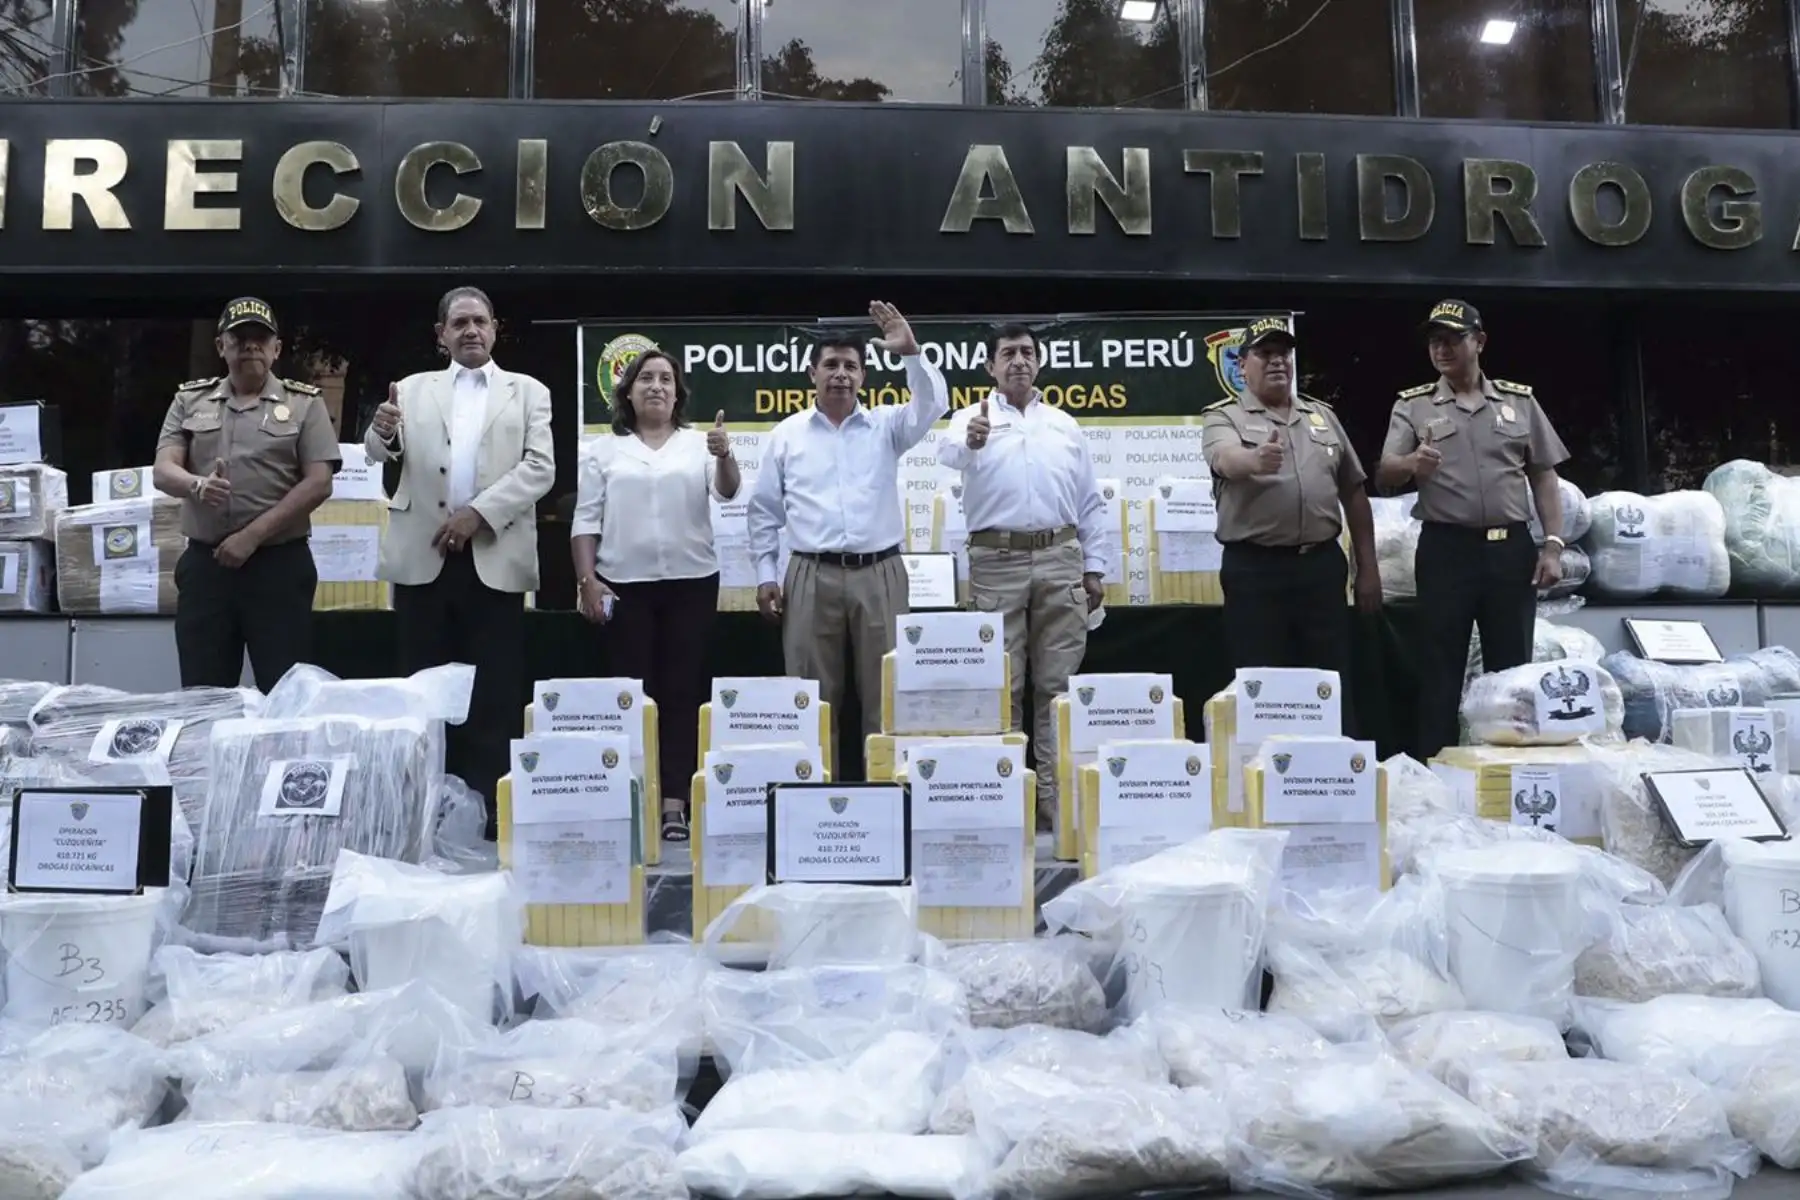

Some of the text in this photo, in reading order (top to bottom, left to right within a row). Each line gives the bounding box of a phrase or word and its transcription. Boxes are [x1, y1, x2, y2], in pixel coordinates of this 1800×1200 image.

[0, 115, 1800, 250] RECCIÓN ANTIDROG
[229, 301, 271, 322] POLICIA
[1102, 331, 1194, 367] PERÚ
[532, 787, 579, 795] ANTIDROGAS
[37, 862, 69, 870] DROGAS
[798, 856, 831, 864] DROGAS
